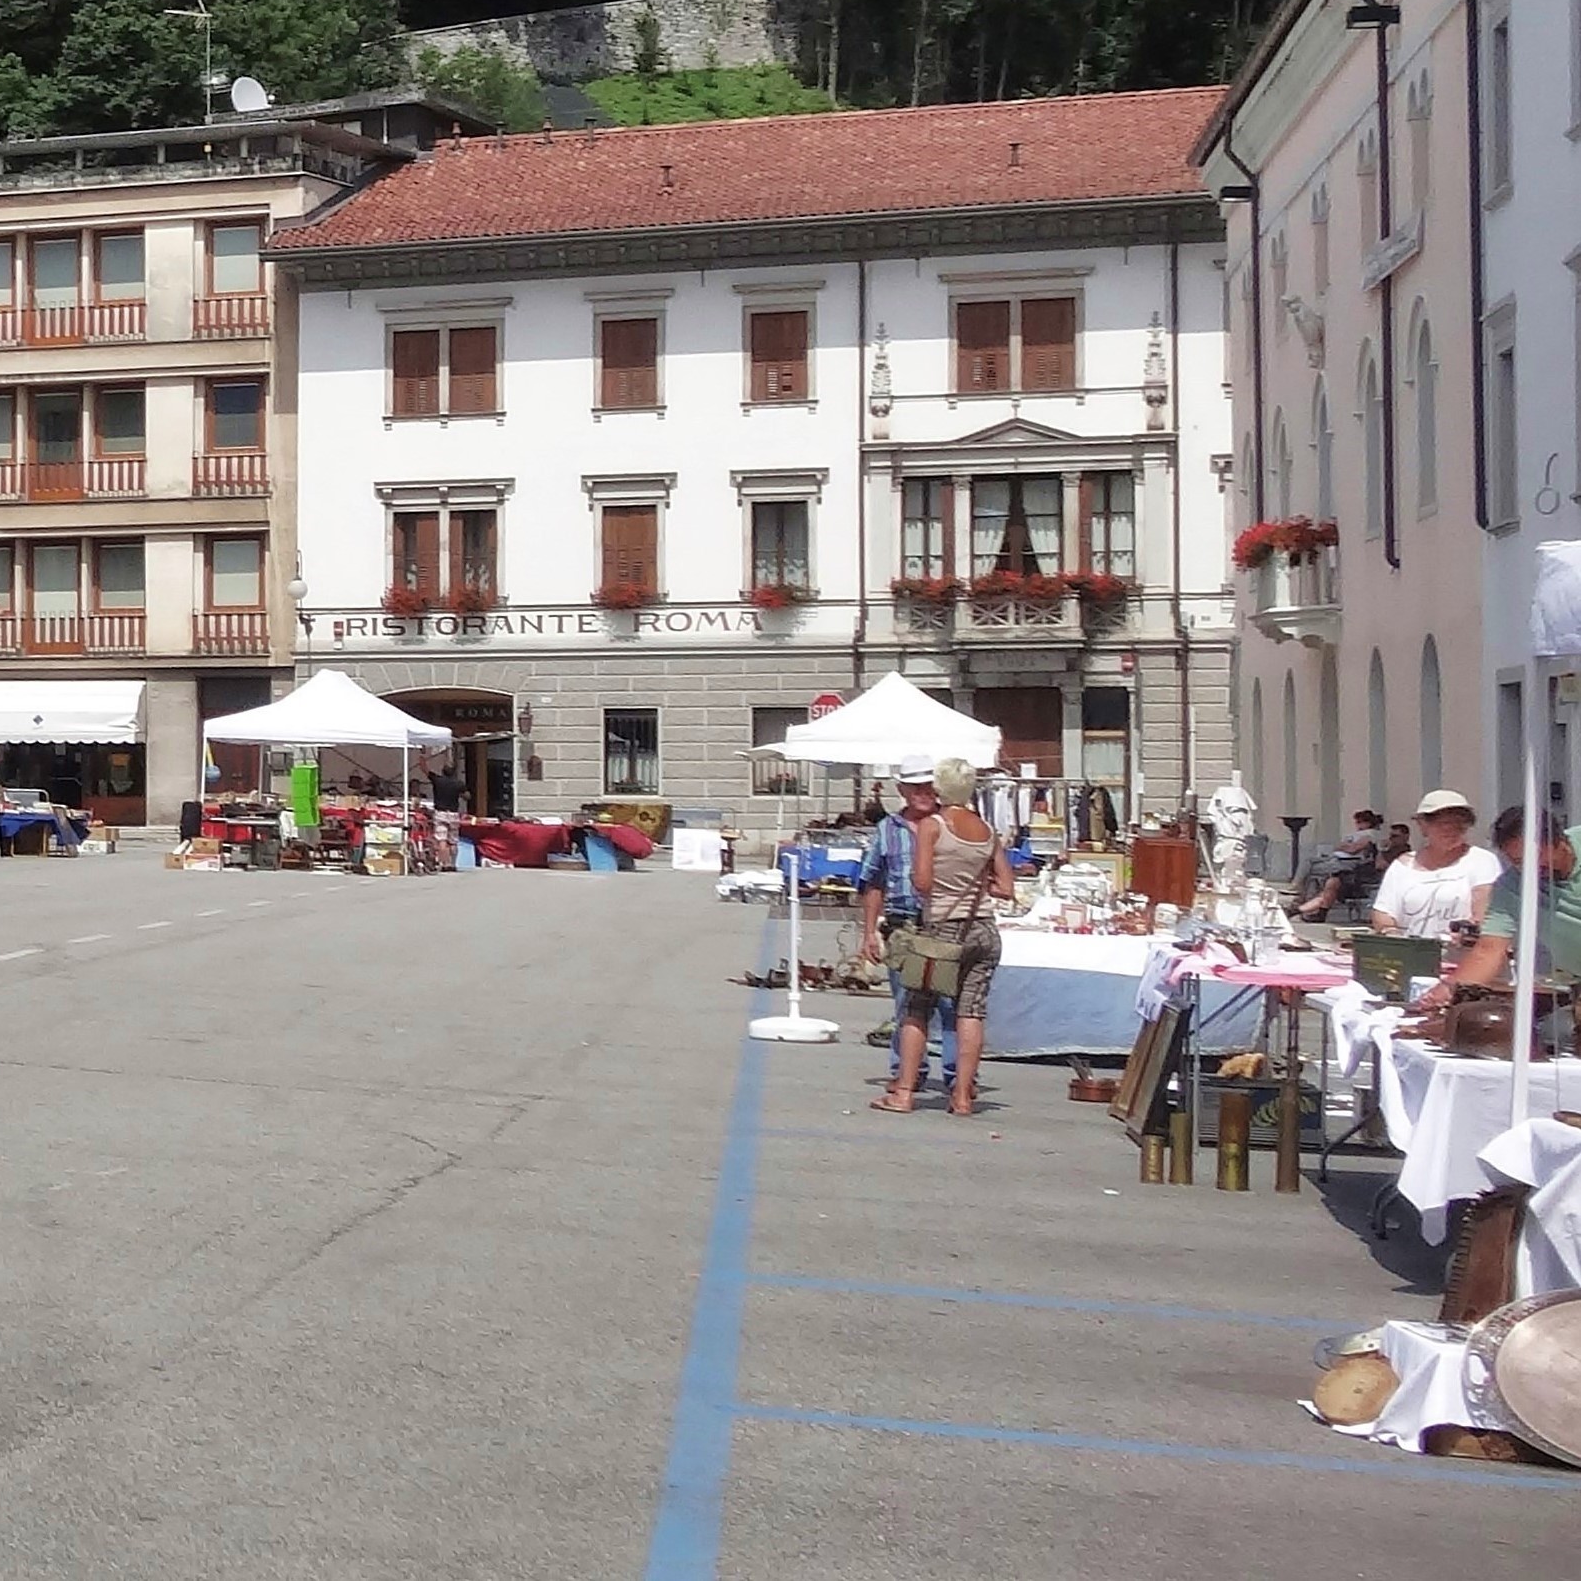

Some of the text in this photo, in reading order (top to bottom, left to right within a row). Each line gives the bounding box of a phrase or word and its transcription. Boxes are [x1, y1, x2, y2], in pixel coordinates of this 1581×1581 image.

[346, 611, 764, 636] RISTORANTE ROMA
[455, 708, 507, 718] ROMA
[811, 704, 841, 719] STO
